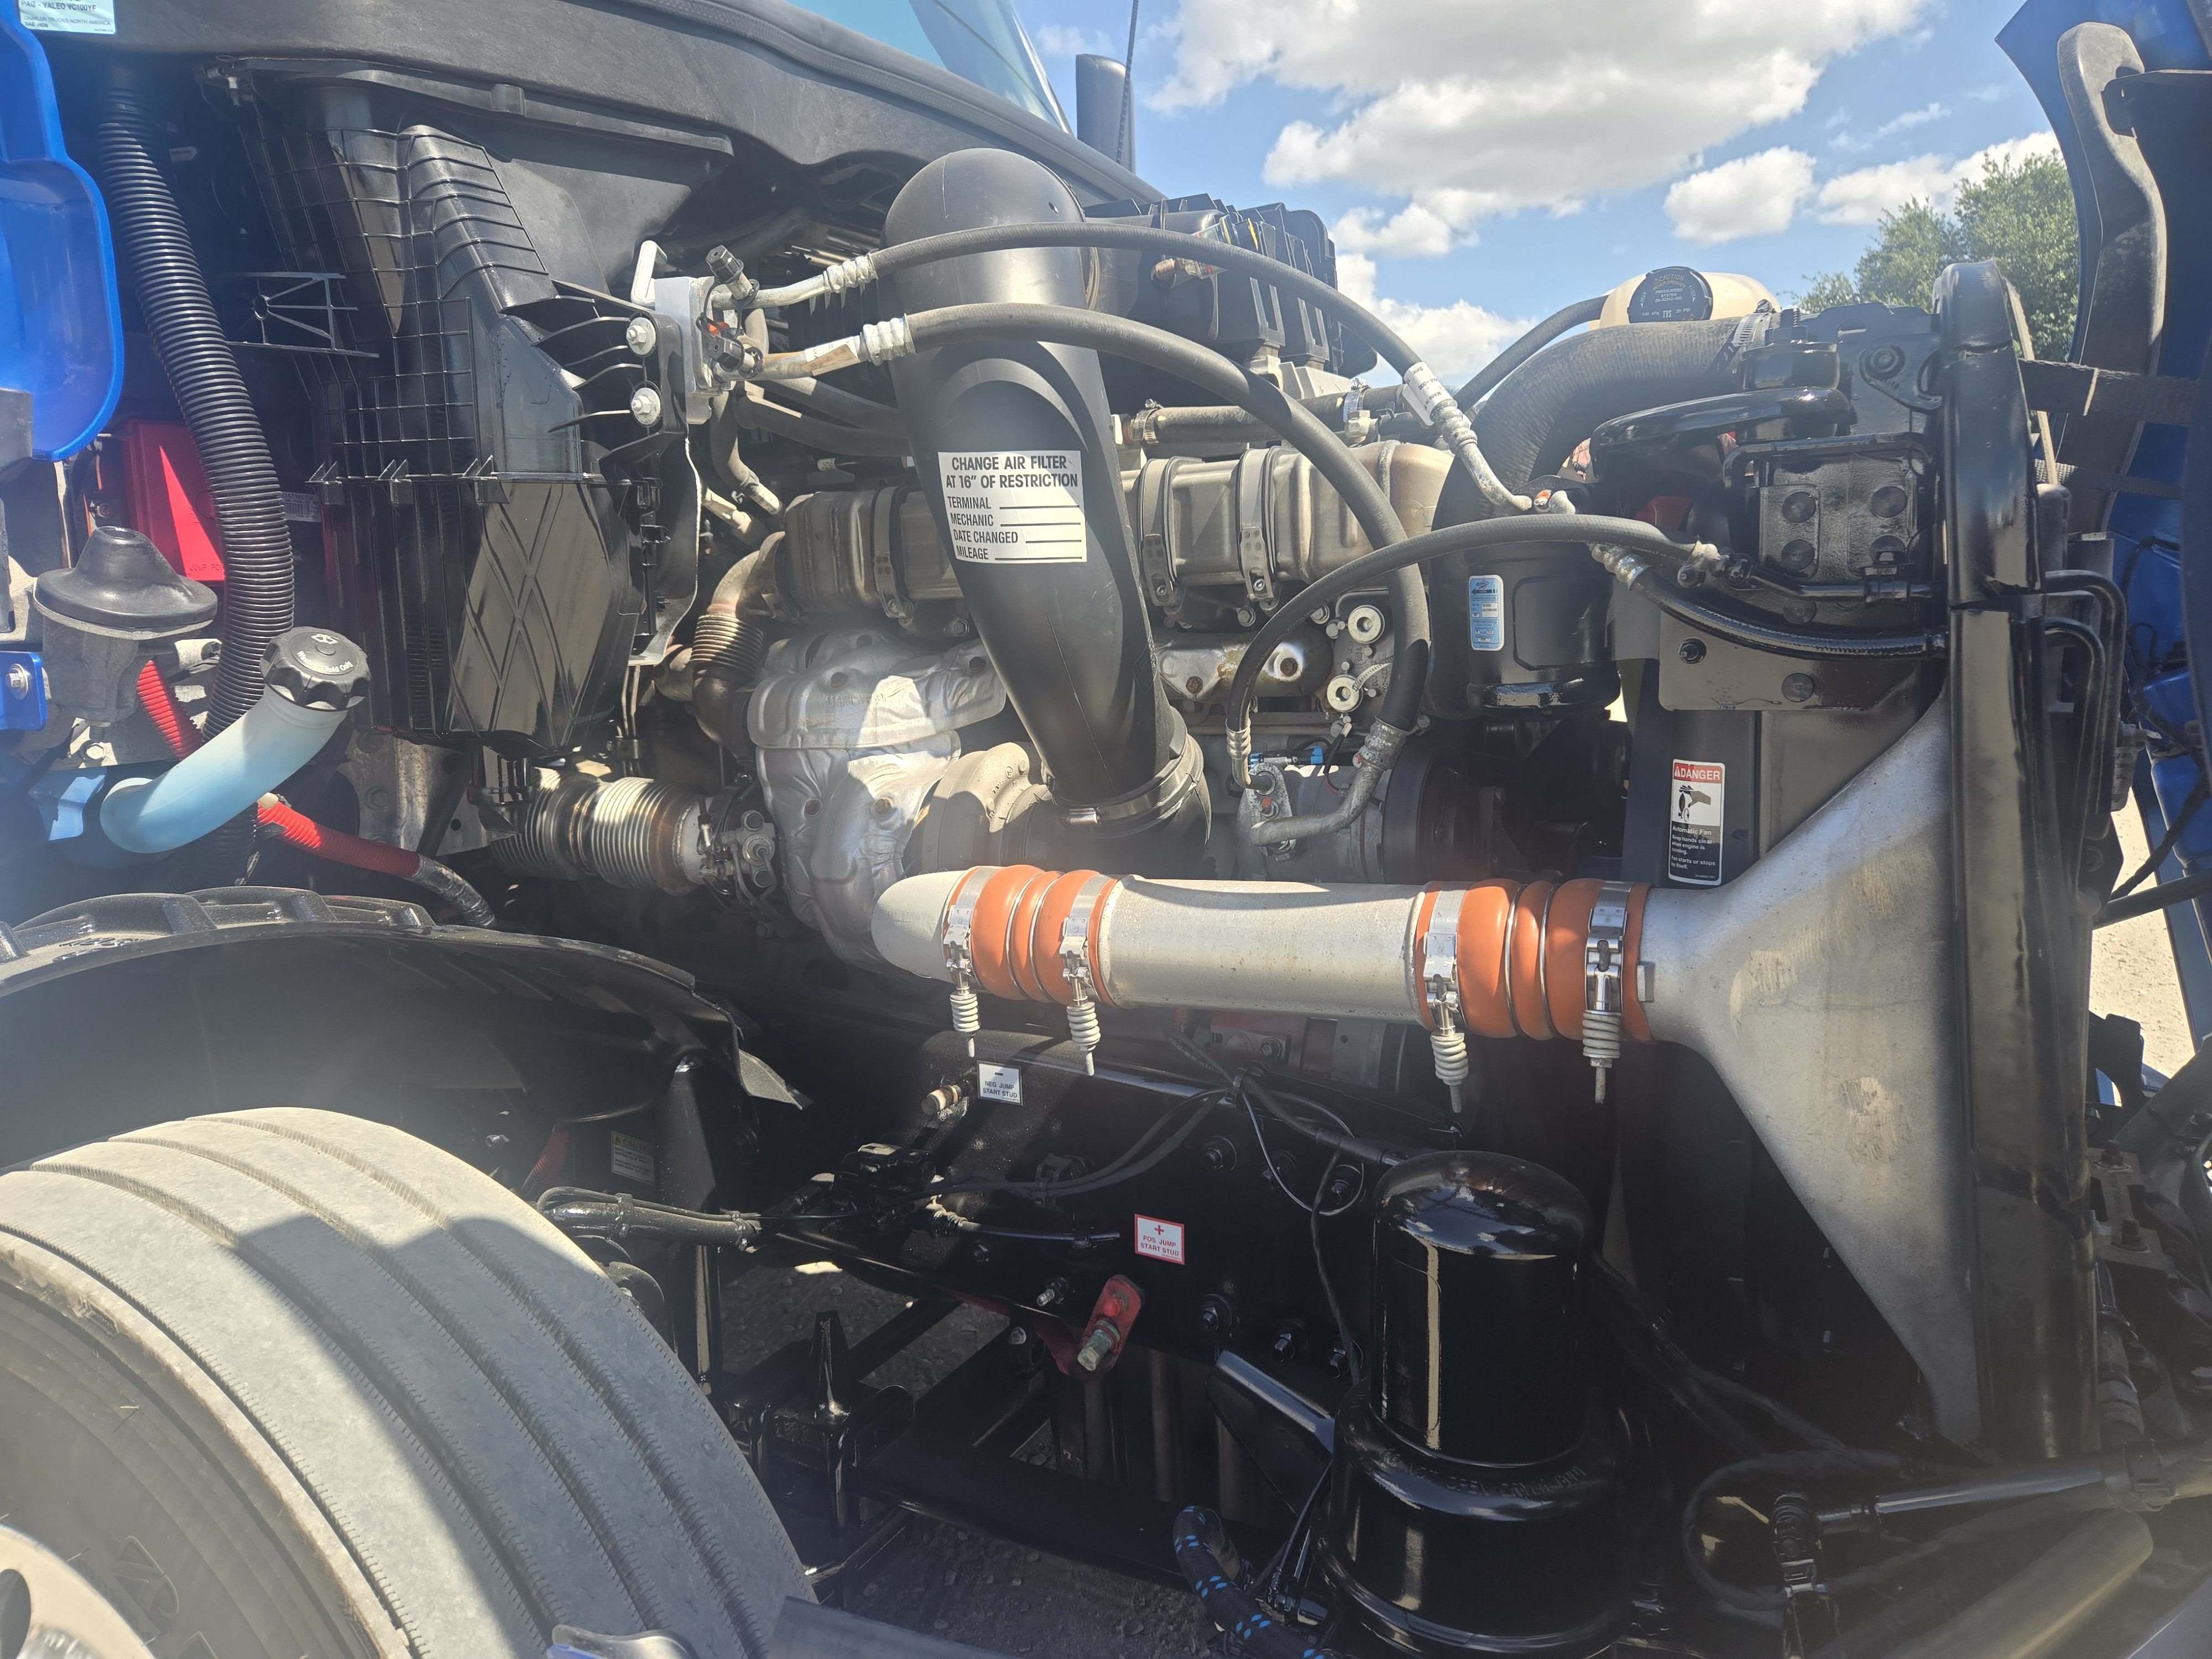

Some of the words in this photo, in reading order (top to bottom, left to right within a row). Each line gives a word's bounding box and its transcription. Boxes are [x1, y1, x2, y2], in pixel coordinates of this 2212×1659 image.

[43, 2, 66, 10] VALEO
[67, 3, 96, 12] VC100YF
[1659, 273, 1685, 282] CAUTION
[1652, 281, 1666, 291] NEVER
[1663, 310, 1672, 318] TVS
[1106, 327, 1115, 336] PET
[951, 456, 999, 470] CHANGE
[1004, 455, 1026, 470] AIR
[1030, 455, 1067, 469] FILTER
[946, 474, 956, 488] AT
[958, 474, 977, 489] 16"
[980, 474, 996, 489] OF
[999, 473, 1078, 488] RESTRICTION
[947, 496, 992, 510] TERMINAL
[950, 513, 994, 527] MECHANIC
[953, 529, 972, 543] DATE
[973, 531, 1018, 544] CHANGED
[956, 545, 989, 560] MILEAGE
[296, 651, 319, 670] Washer
[339, 660, 354, 671] Only
[1681, 769, 1720, 781] DANGER
[1672, 825, 1698, 835] Automatic
[983, 1087, 1001, 1095] START
[1159, 1239, 1176, 1247] JUMP
[1141, 1243, 1161, 1252] START
[1162, 1248, 1179, 1256] STUD
